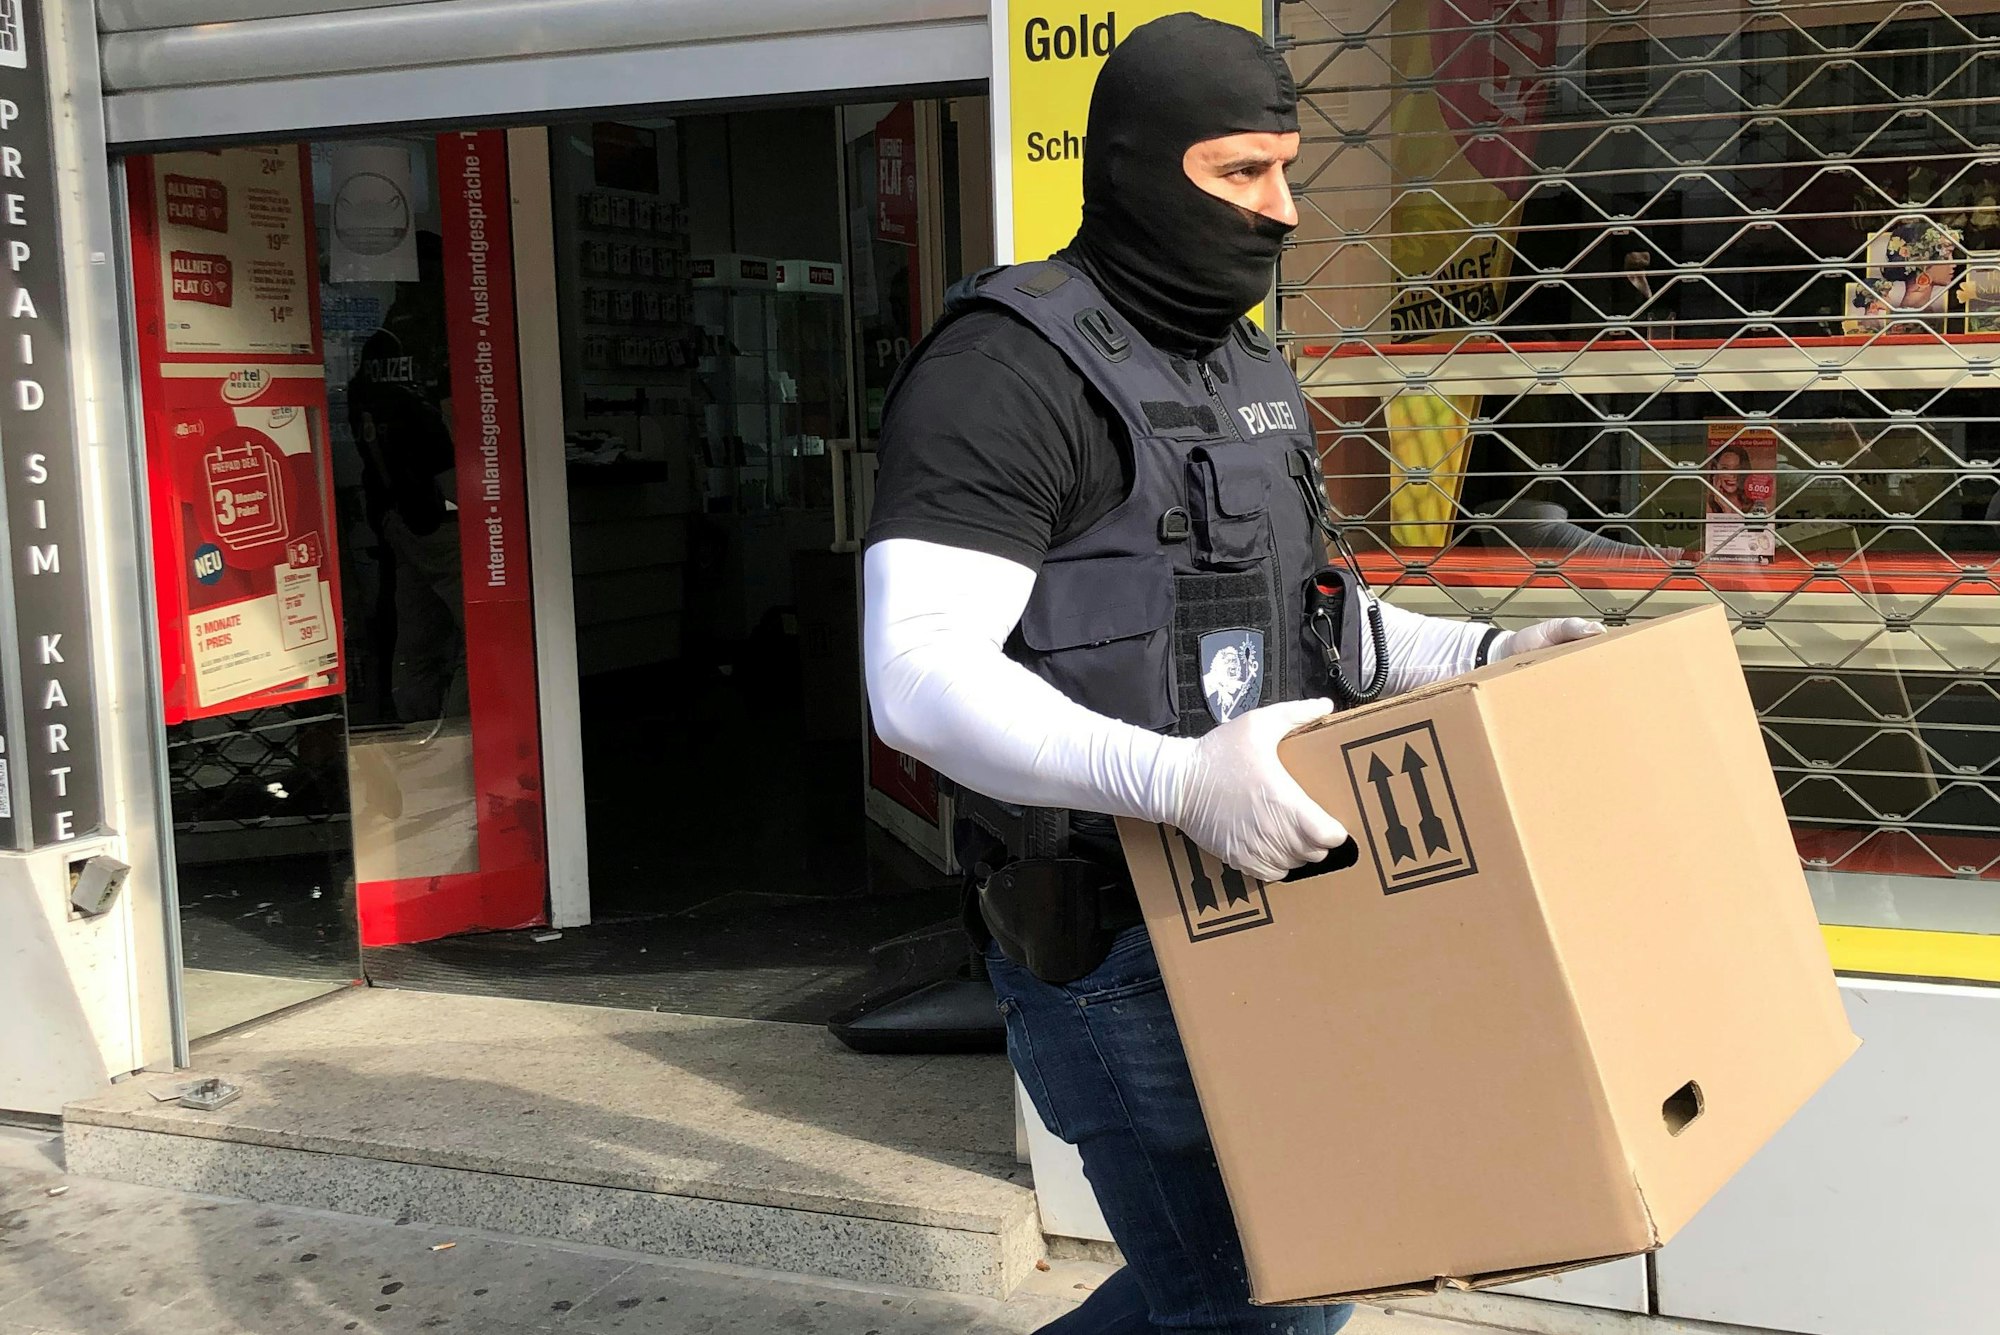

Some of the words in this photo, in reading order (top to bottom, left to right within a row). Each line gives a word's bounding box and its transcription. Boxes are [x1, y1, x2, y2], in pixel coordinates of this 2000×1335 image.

[1024, 11, 1116, 62] Gold
[1027, 130, 1086, 162] Sch
[0, 98, 45, 411] PREPAID
[463, 155, 491, 327] Auslandgespräche
[174, 259, 213, 274] ALLNET
[174, 279, 200, 294] FLAT
[229, 369, 261, 382] ortel
[474, 341, 501, 501] Inlandsgespräche
[1237, 401, 1297, 435] POLIZEI
[241, 457, 259, 469] DEAL
[1748, 483, 1770, 494] 5.000
[27, 453, 60, 576] SIM
[215, 489, 236, 525] 3
[194, 550, 222, 579] NEU
[298, 543, 309, 563] 3
[485, 517, 506, 587] Internet
[195, 625, 202, 637] 3
[204, 614, 241, 635] MONATE
[197, 641, 204, 653] 1
[206, 633, 232, 650] PREIS
[41, 633, 75, 841] KARTE
